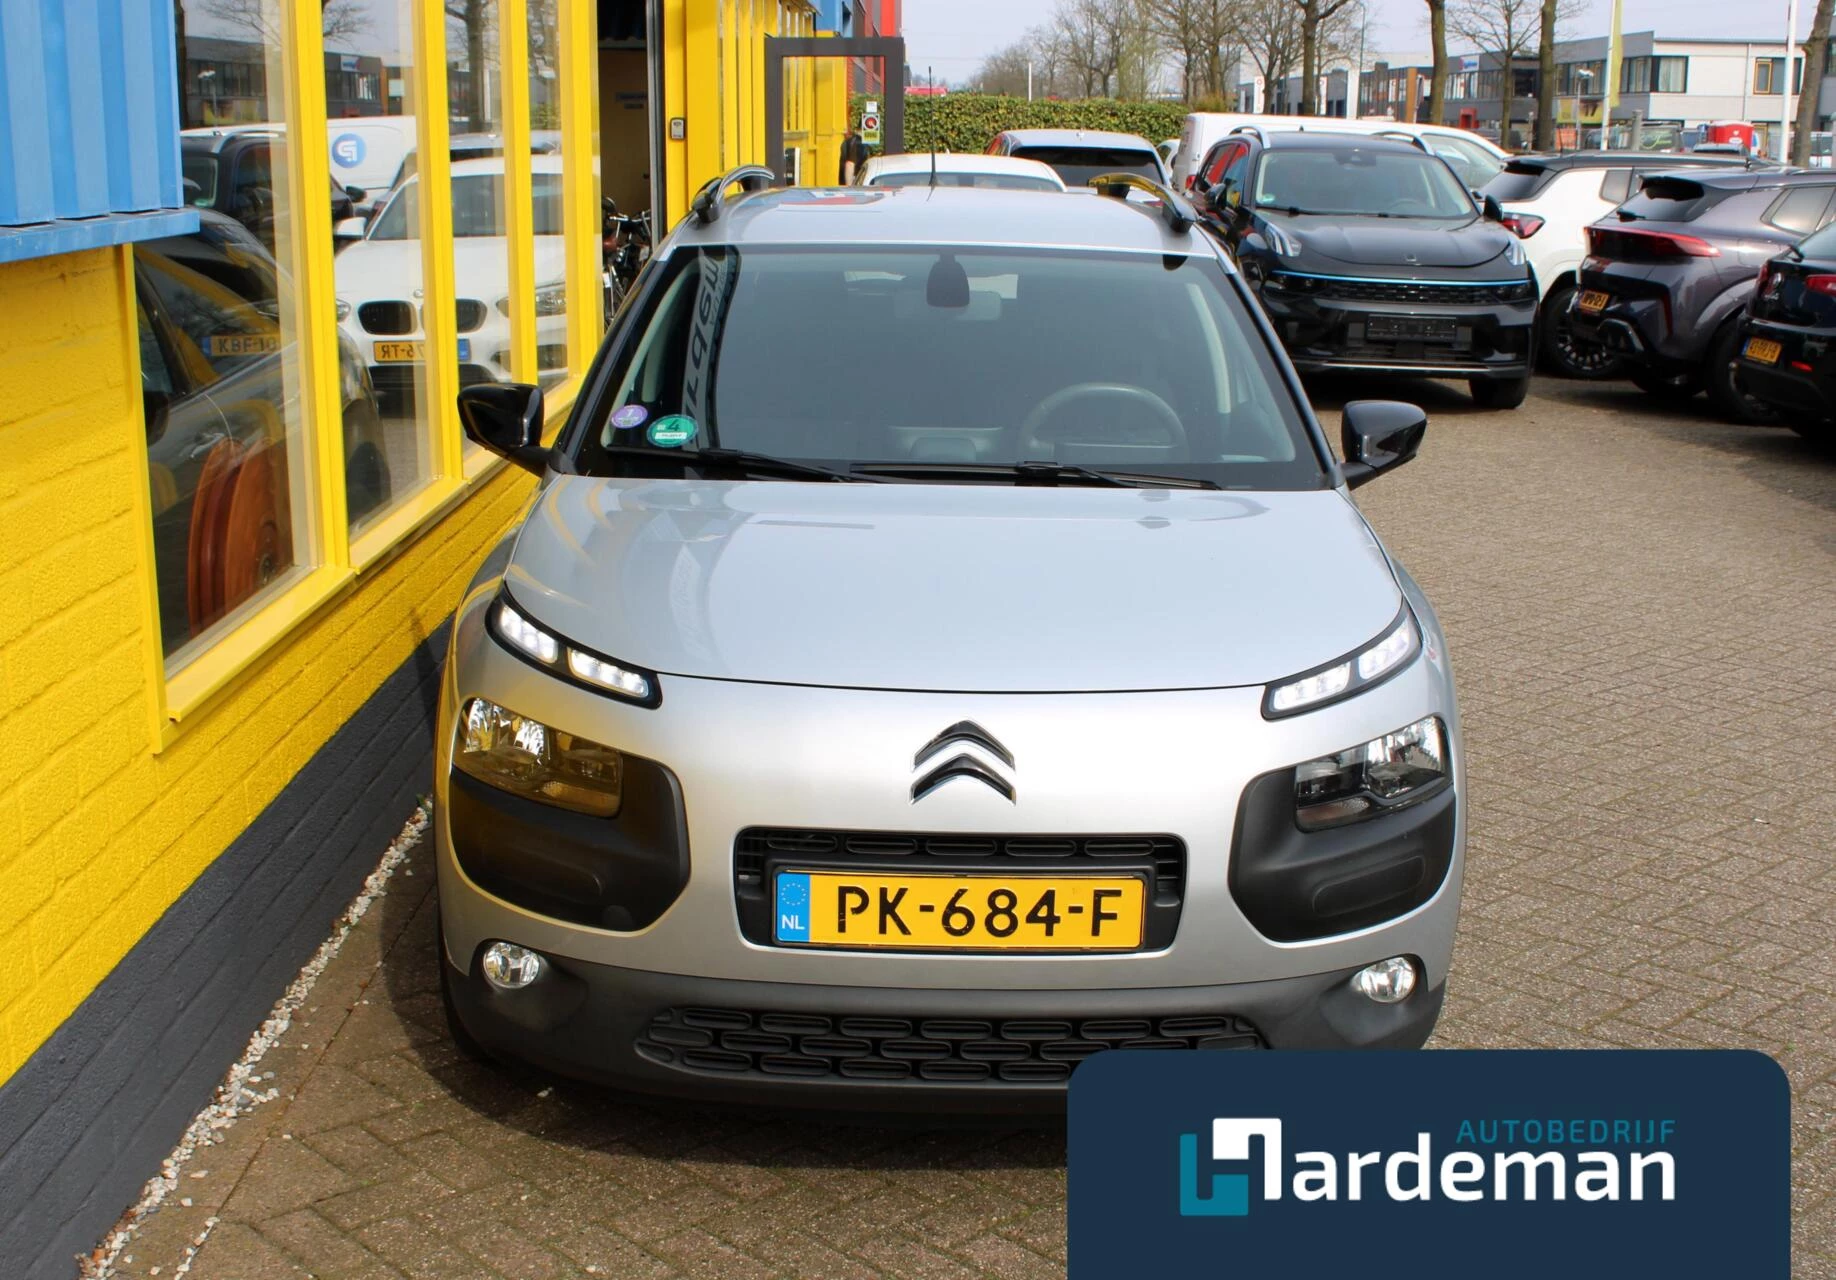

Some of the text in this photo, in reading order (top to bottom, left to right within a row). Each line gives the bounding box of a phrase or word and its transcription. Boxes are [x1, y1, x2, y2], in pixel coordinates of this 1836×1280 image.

[667, 419, 680, 431] 4
[837, 885, 1123, 938] PK-684-F
[781, 914, 805, 931] NL
